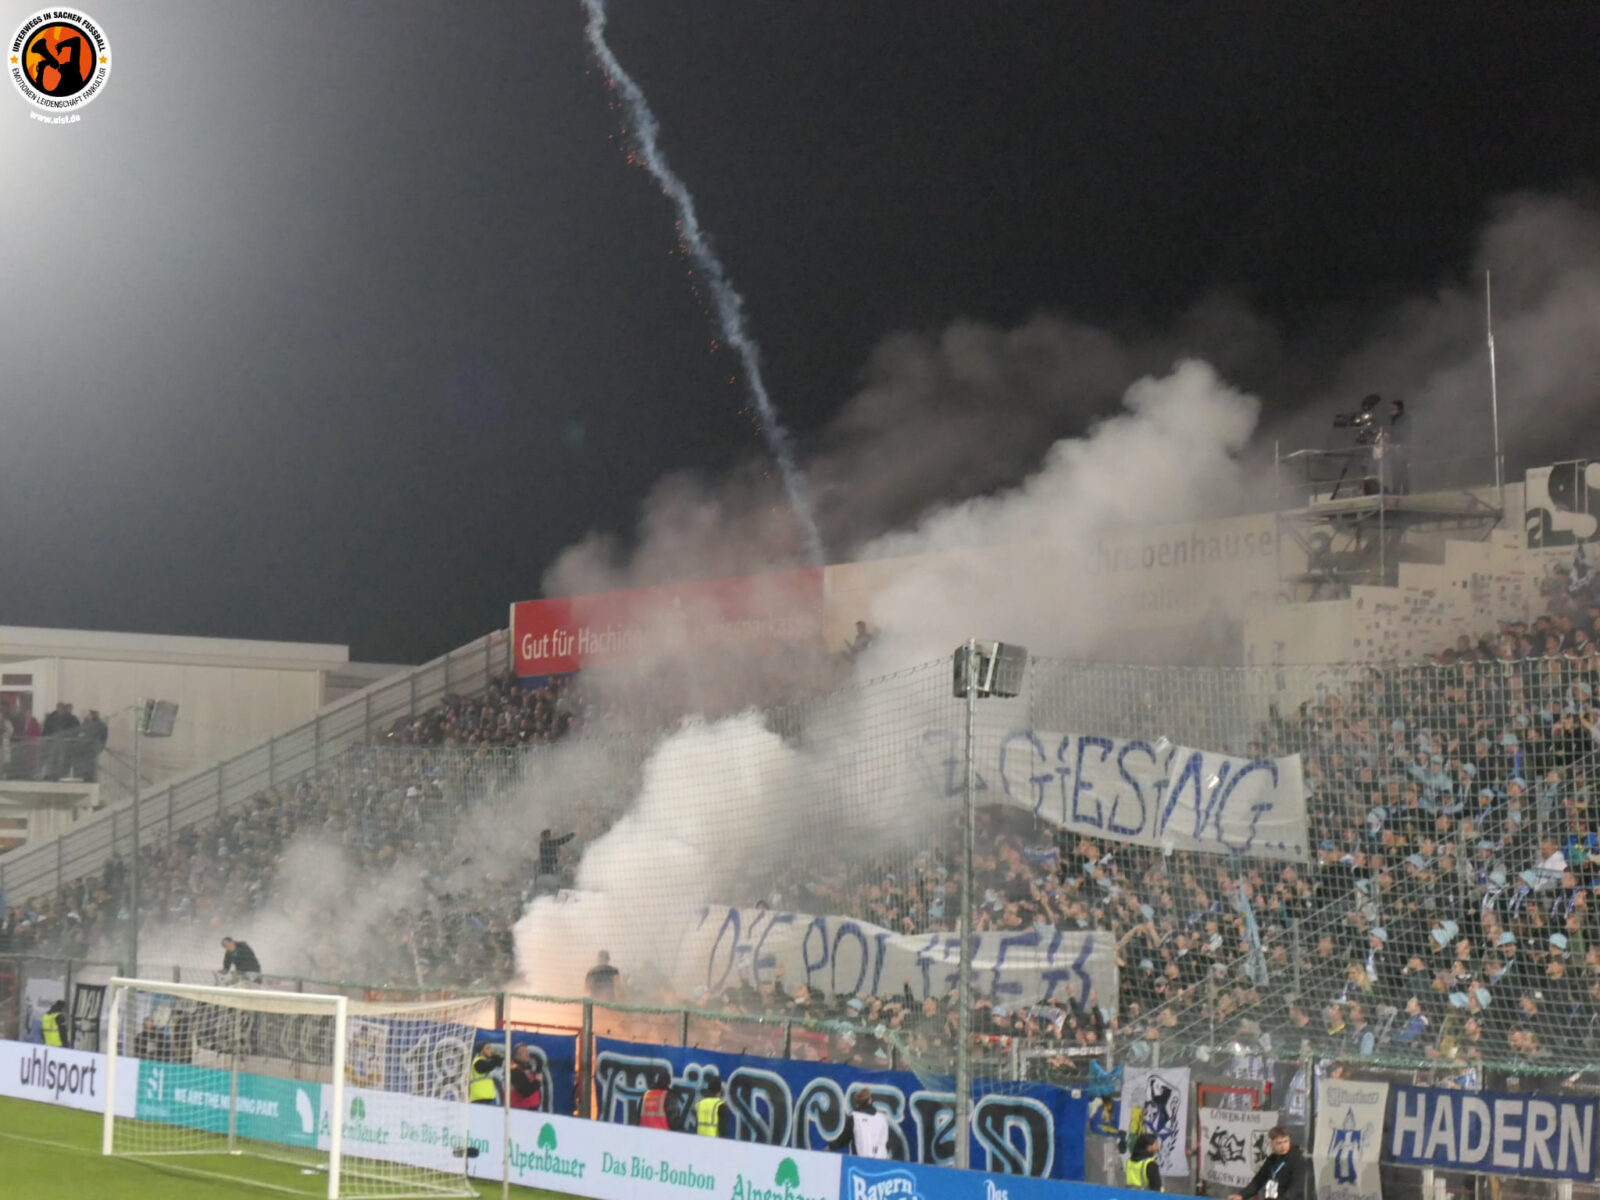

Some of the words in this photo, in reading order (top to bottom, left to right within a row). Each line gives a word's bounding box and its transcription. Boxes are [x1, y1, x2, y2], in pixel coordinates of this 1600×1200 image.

[521, 633, 549, 660] Gut
[552, 629, 575, 657] für
[20, 1047, 97, 1101] uhlsport
[319, 1111, 389, 1145] Aenbauer
[602, 1152, 627, 1177] Das
[630, 1155, 715, 1191] Bio-Bonbon
[1392, 1090, 1594, 1174] HADERN
